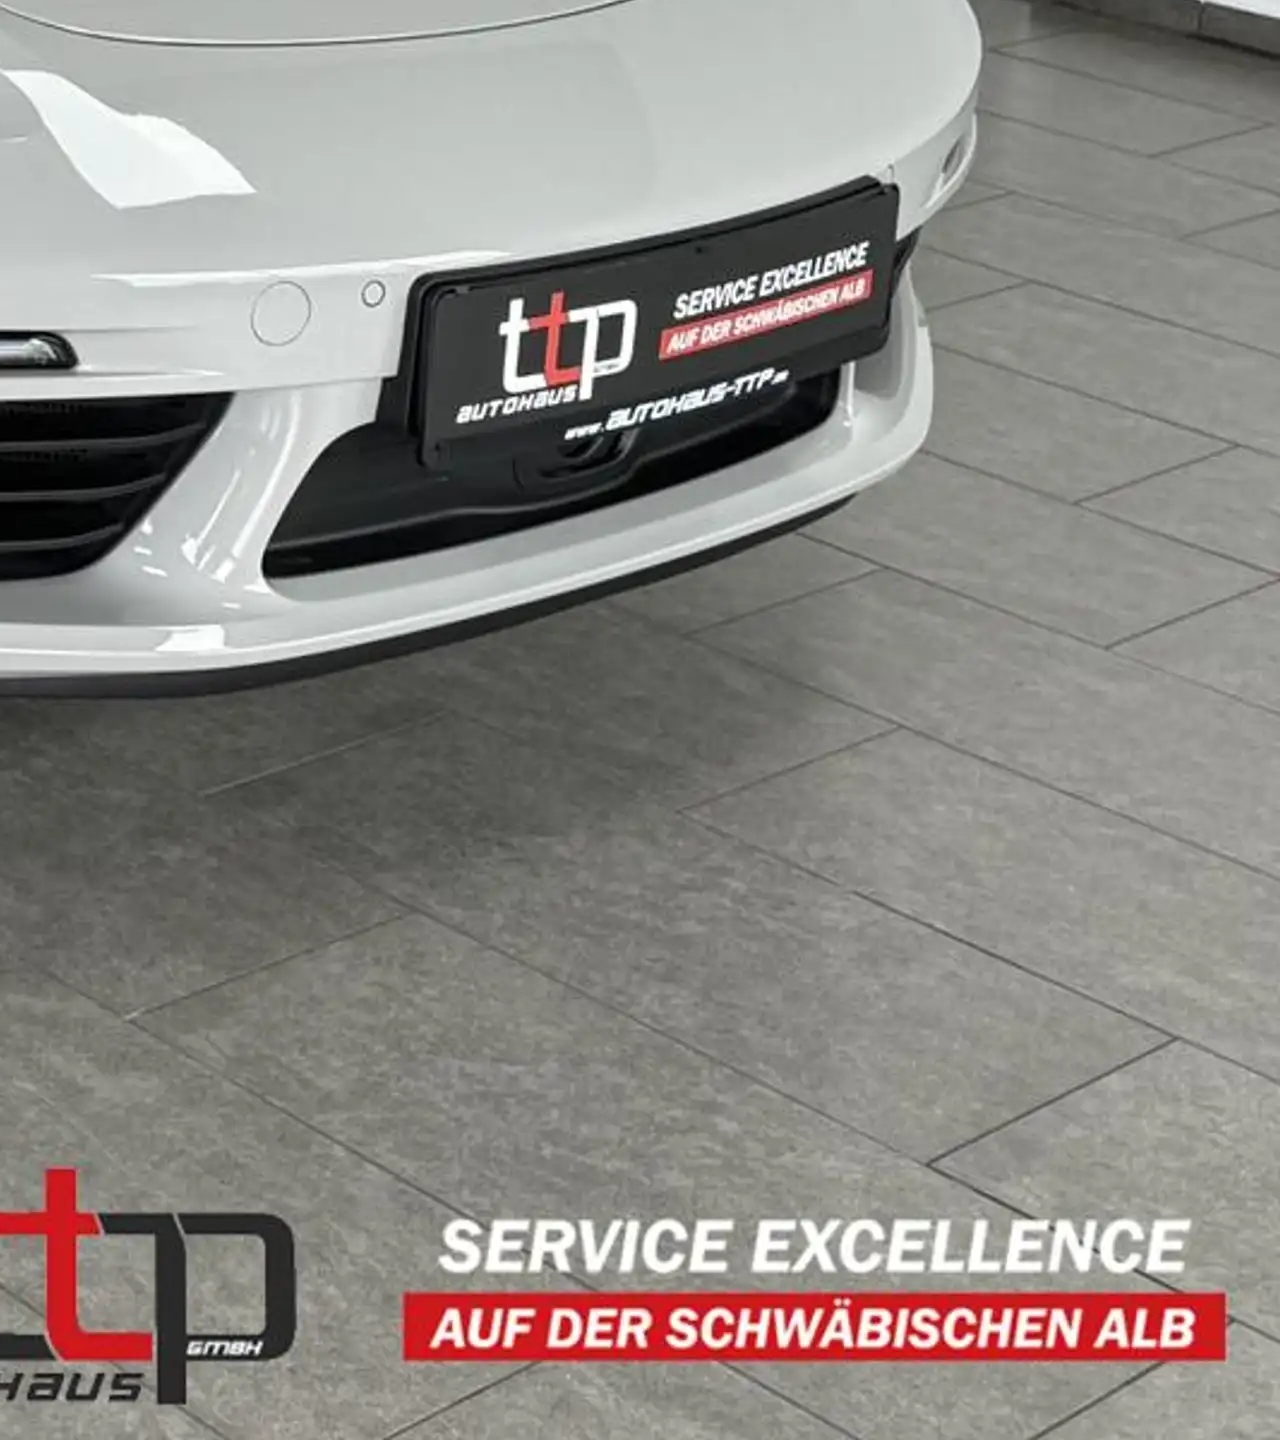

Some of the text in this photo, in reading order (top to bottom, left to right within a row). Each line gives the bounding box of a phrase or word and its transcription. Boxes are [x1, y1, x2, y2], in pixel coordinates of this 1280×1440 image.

[672, 240, 870, 320] SERVICE EXCELLENCE
[499, 290, 638, 400] ttp
[666, 327, 700, 355] AUF
[701, 320, 732, 346] DER
